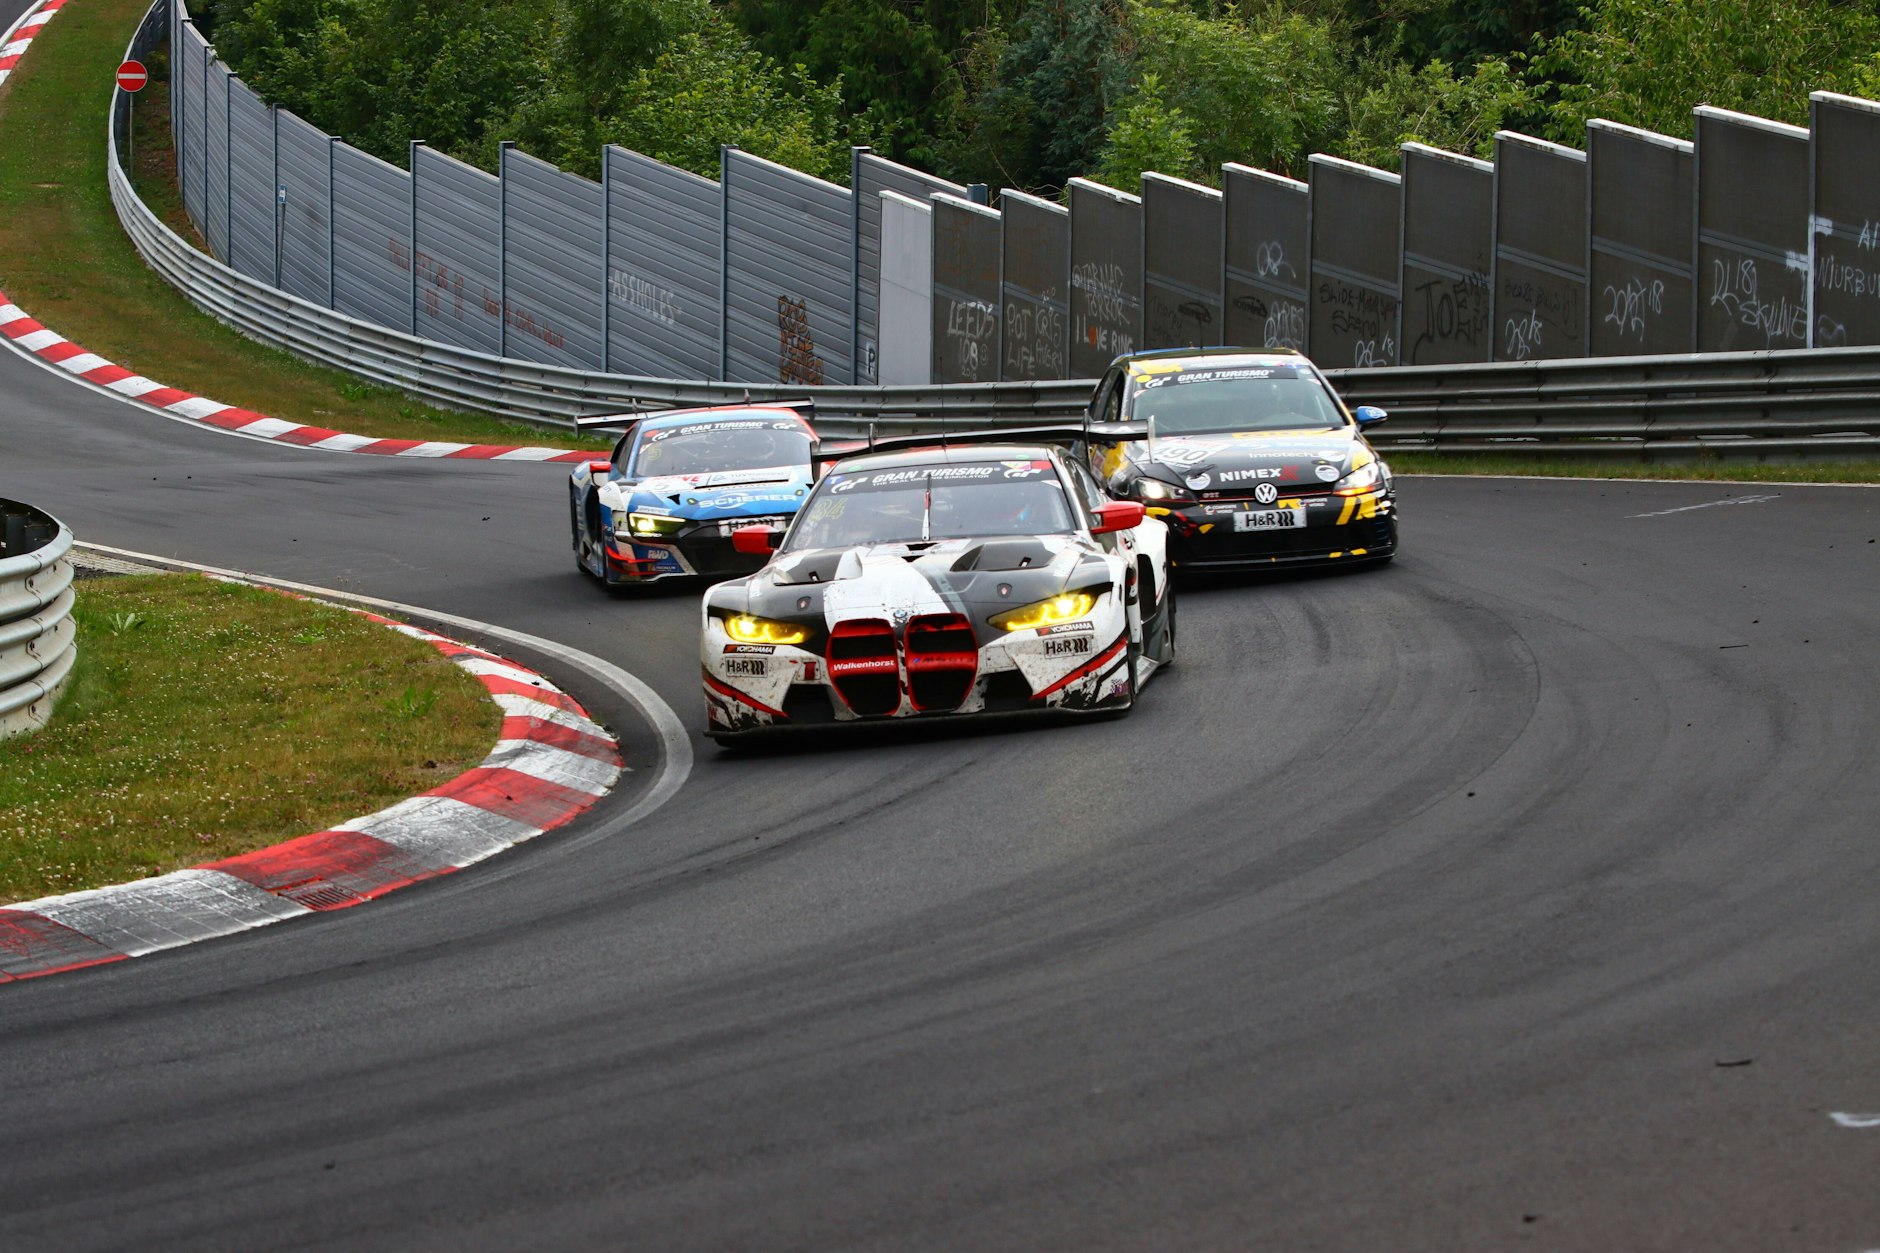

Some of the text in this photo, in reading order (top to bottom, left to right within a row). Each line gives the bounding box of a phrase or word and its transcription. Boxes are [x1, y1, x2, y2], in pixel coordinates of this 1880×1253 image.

[947, 300, 995, 339] LEEDS
[1177, 372, 1212, 383] GRAN
[680, 424, 712, 435] GRAN
[872, 471, 918, 484] GRAN
[699, 494, 797, 508] SCHERER
[1050, 621, 1093, 633] YOKOHAMA
[1045, 639, 1072, 655] H&R
[727, 660, 749, 673] H&R
[833, 659, 896, 672] Walkenhorst
